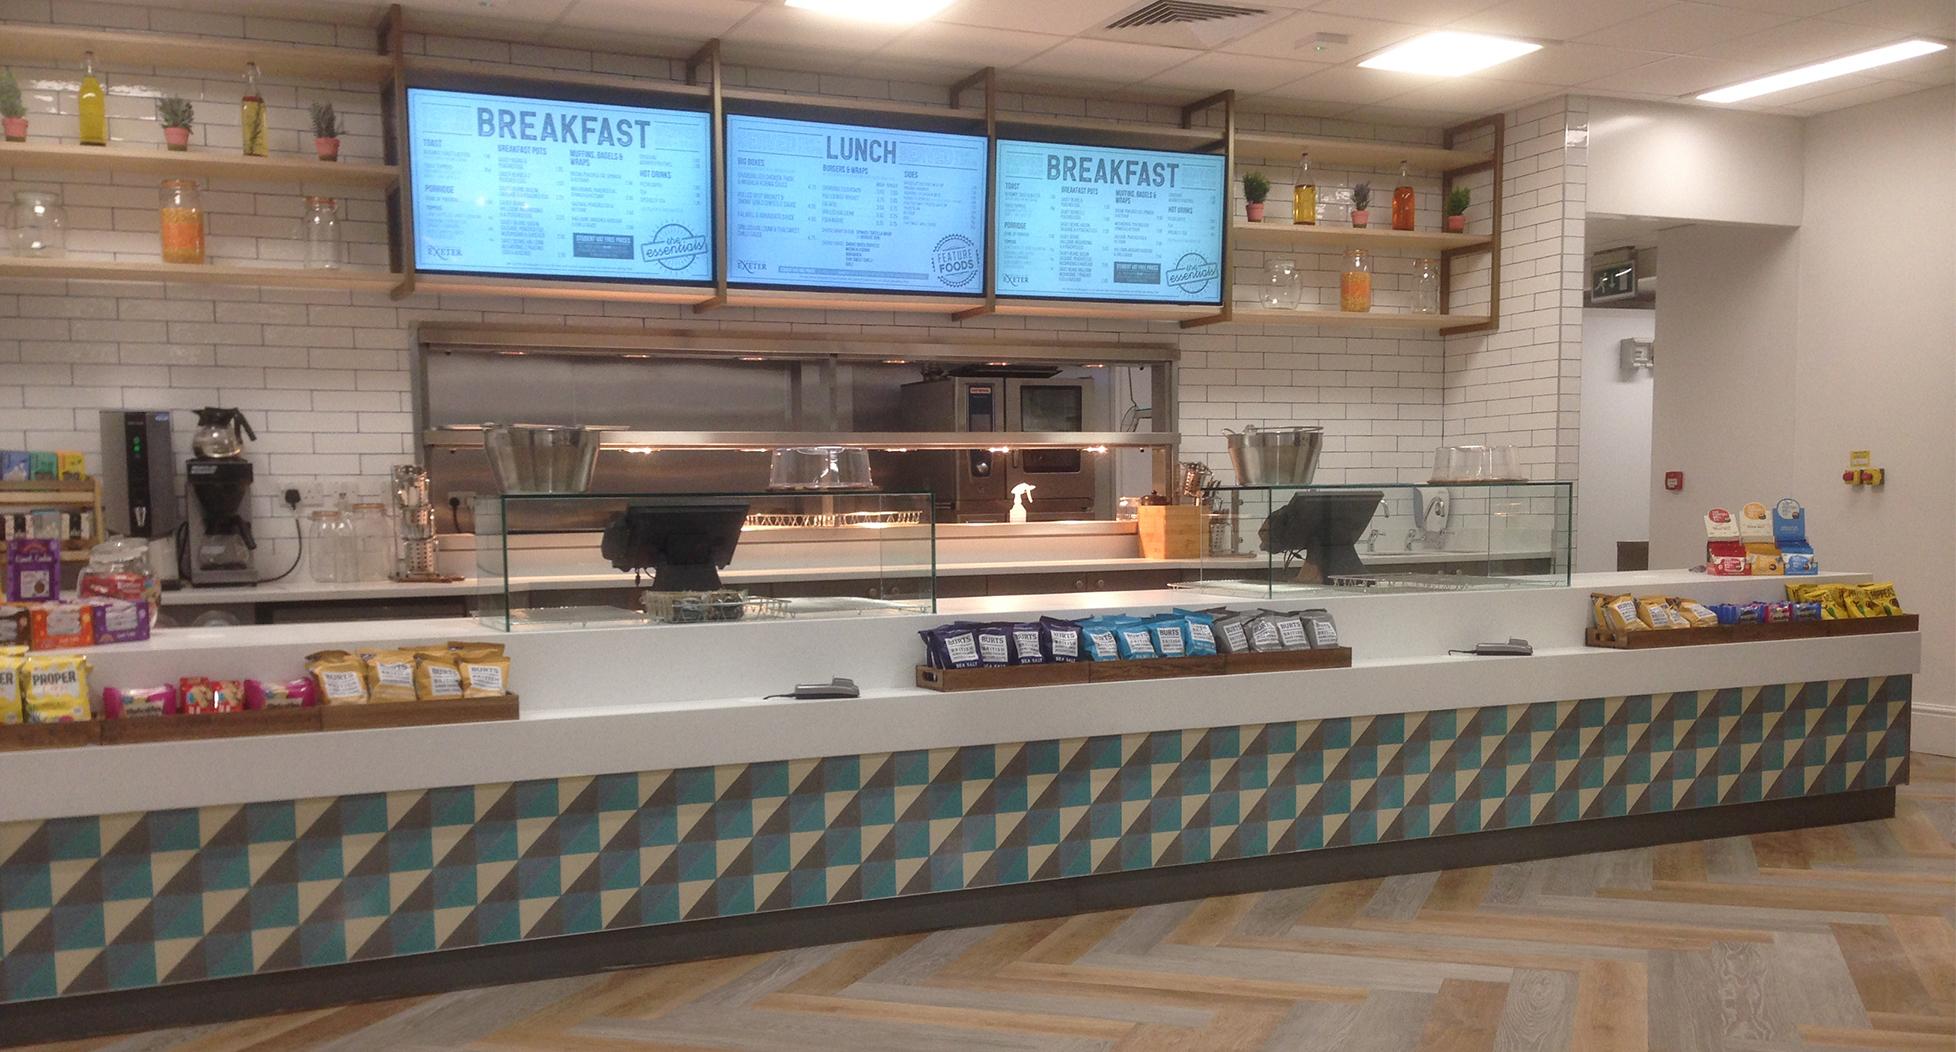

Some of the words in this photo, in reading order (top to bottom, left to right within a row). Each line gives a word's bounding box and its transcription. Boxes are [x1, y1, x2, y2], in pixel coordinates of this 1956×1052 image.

[476, 107, 651, 149] BREAKFAST
[423, 139, 442, 148] TOAST
[498, 144, 531, 154] BREAKFAST
[532, 146, 547, 155] POTS
[826, 135, 897, 164] LUNCH
[597, 151, 618, 160] BAGELS
[570, 158, 590, 166] WRAPS
[738, 157, 747, 165] BIG
[747, 158, 765, 167] BOXES
[639, 170, 651, 178] HOT
[651, 170, 672, 179] DRINKS
[822, 164, 845, 173] BURGERS
[851, 166, 869, 175] WRAPS
[904, 170, 919, 179] SIDES
[1046, 154, 1180, 189] BREAKFAST
[425, 184, 455, 194] PORRIDGE
[1005, 182, 1020, 190] TOAST
[1061, 186, 1087, 194] BREAKFAST
[1004, 221, 1026, 230] PORRIDGE
[665, 236, 681, 244] the
[428, 245, 463, 260] EXETER
[646, 239, 704, 257] essentials
[937, 248, 973, 263] FEATURE
[737, 259, 767, 274] EXETER
[939, 259, 974, 273] FOODS
[1170, 266, 1216, 283] essentials
[1003, 274, 1029, 287] EXETER
[948, 636, 972, 645] BURTS
[32, 670, 77, 686] PROPER
